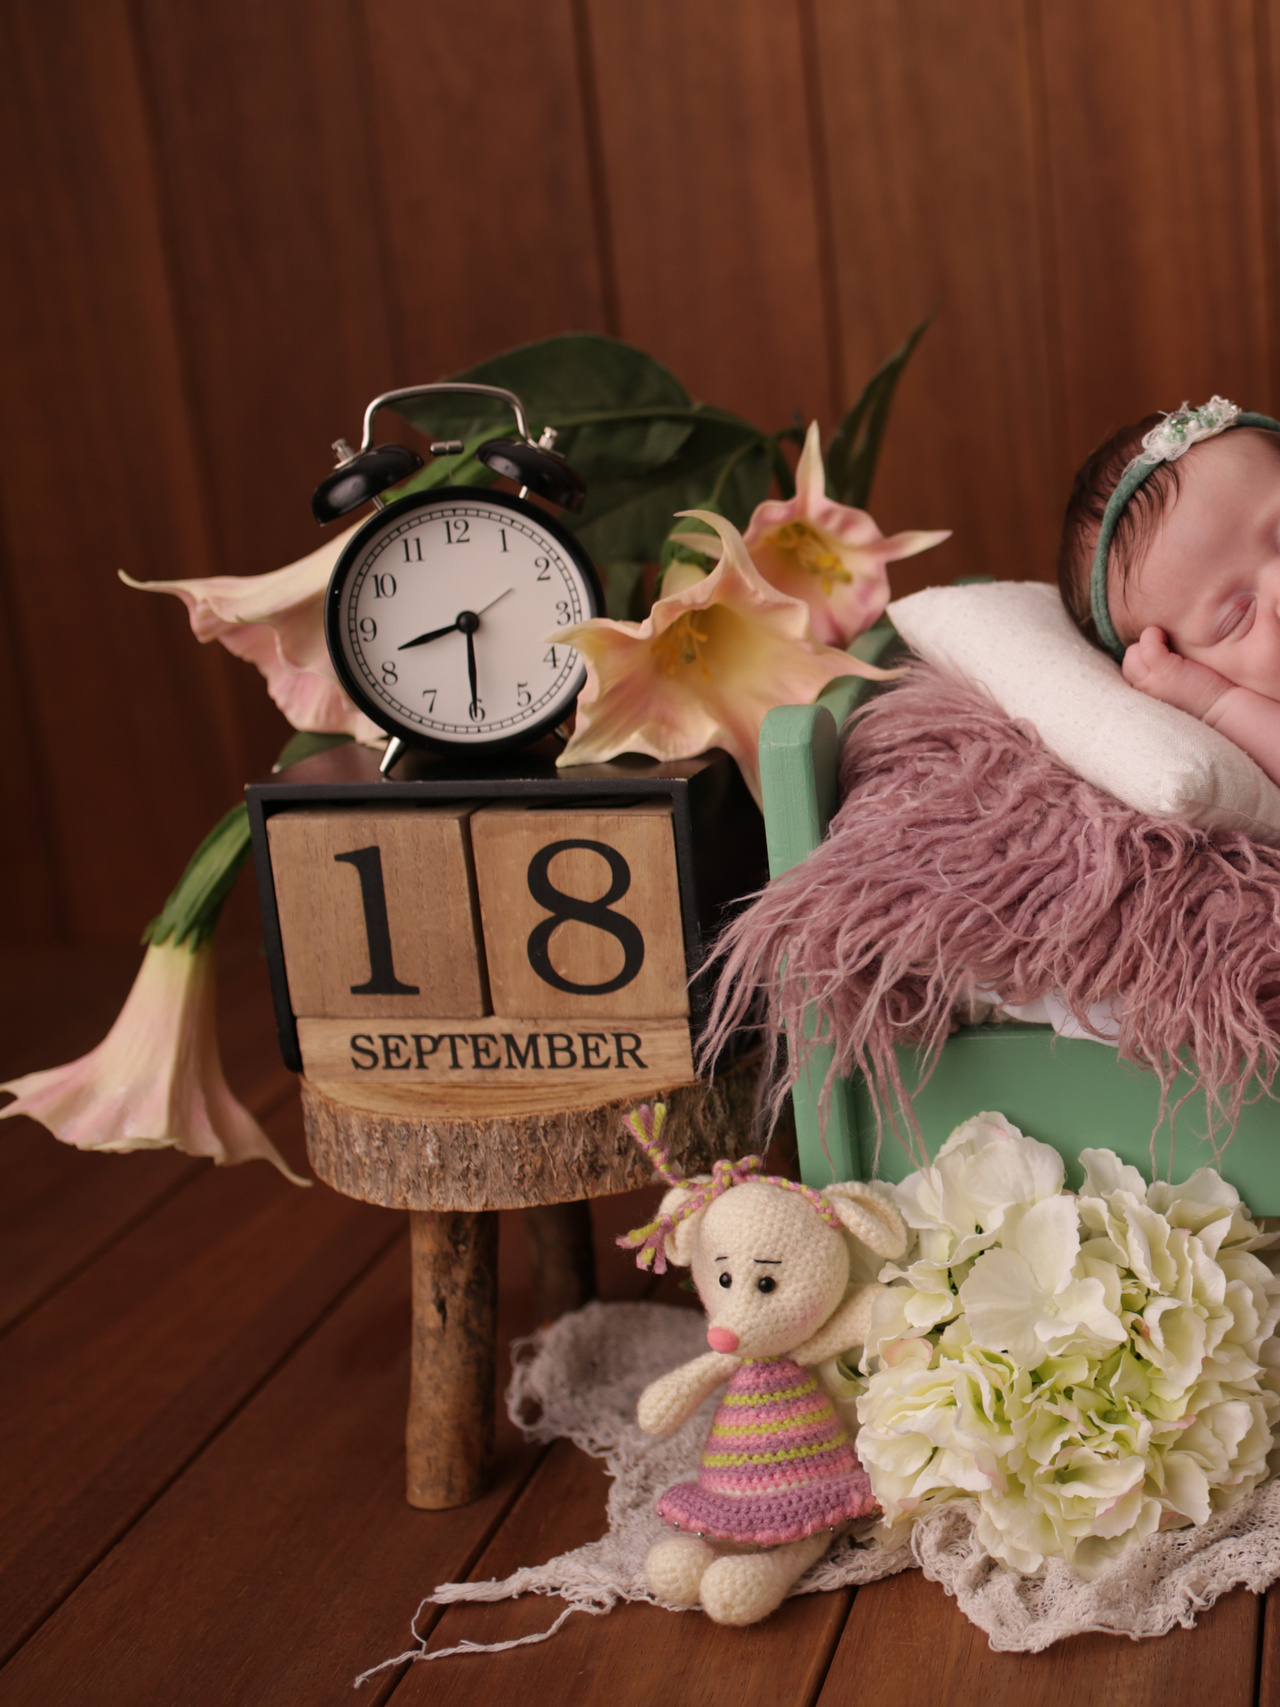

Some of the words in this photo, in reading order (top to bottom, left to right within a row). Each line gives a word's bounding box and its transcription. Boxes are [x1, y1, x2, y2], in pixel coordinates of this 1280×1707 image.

[443, 518, 471, 544] 12
[498, 528, 510, 552] 1
[401, 537, 425, 563] 11
[534, 557, 552, 582] 2
[370, 573, 397, 599] 10
[555, 601, 572, 626] 3
[359, 617, 377, 642] 9
[543, 645, 560, 669] 4
[381, 661, 398, 685] 8
[422, 689, 437, 713] 7
[516, 682, 532, 707] 5
[468, 698, 486, 723] 6
[349, 1033, 649, 1071] SEPTEMBER
